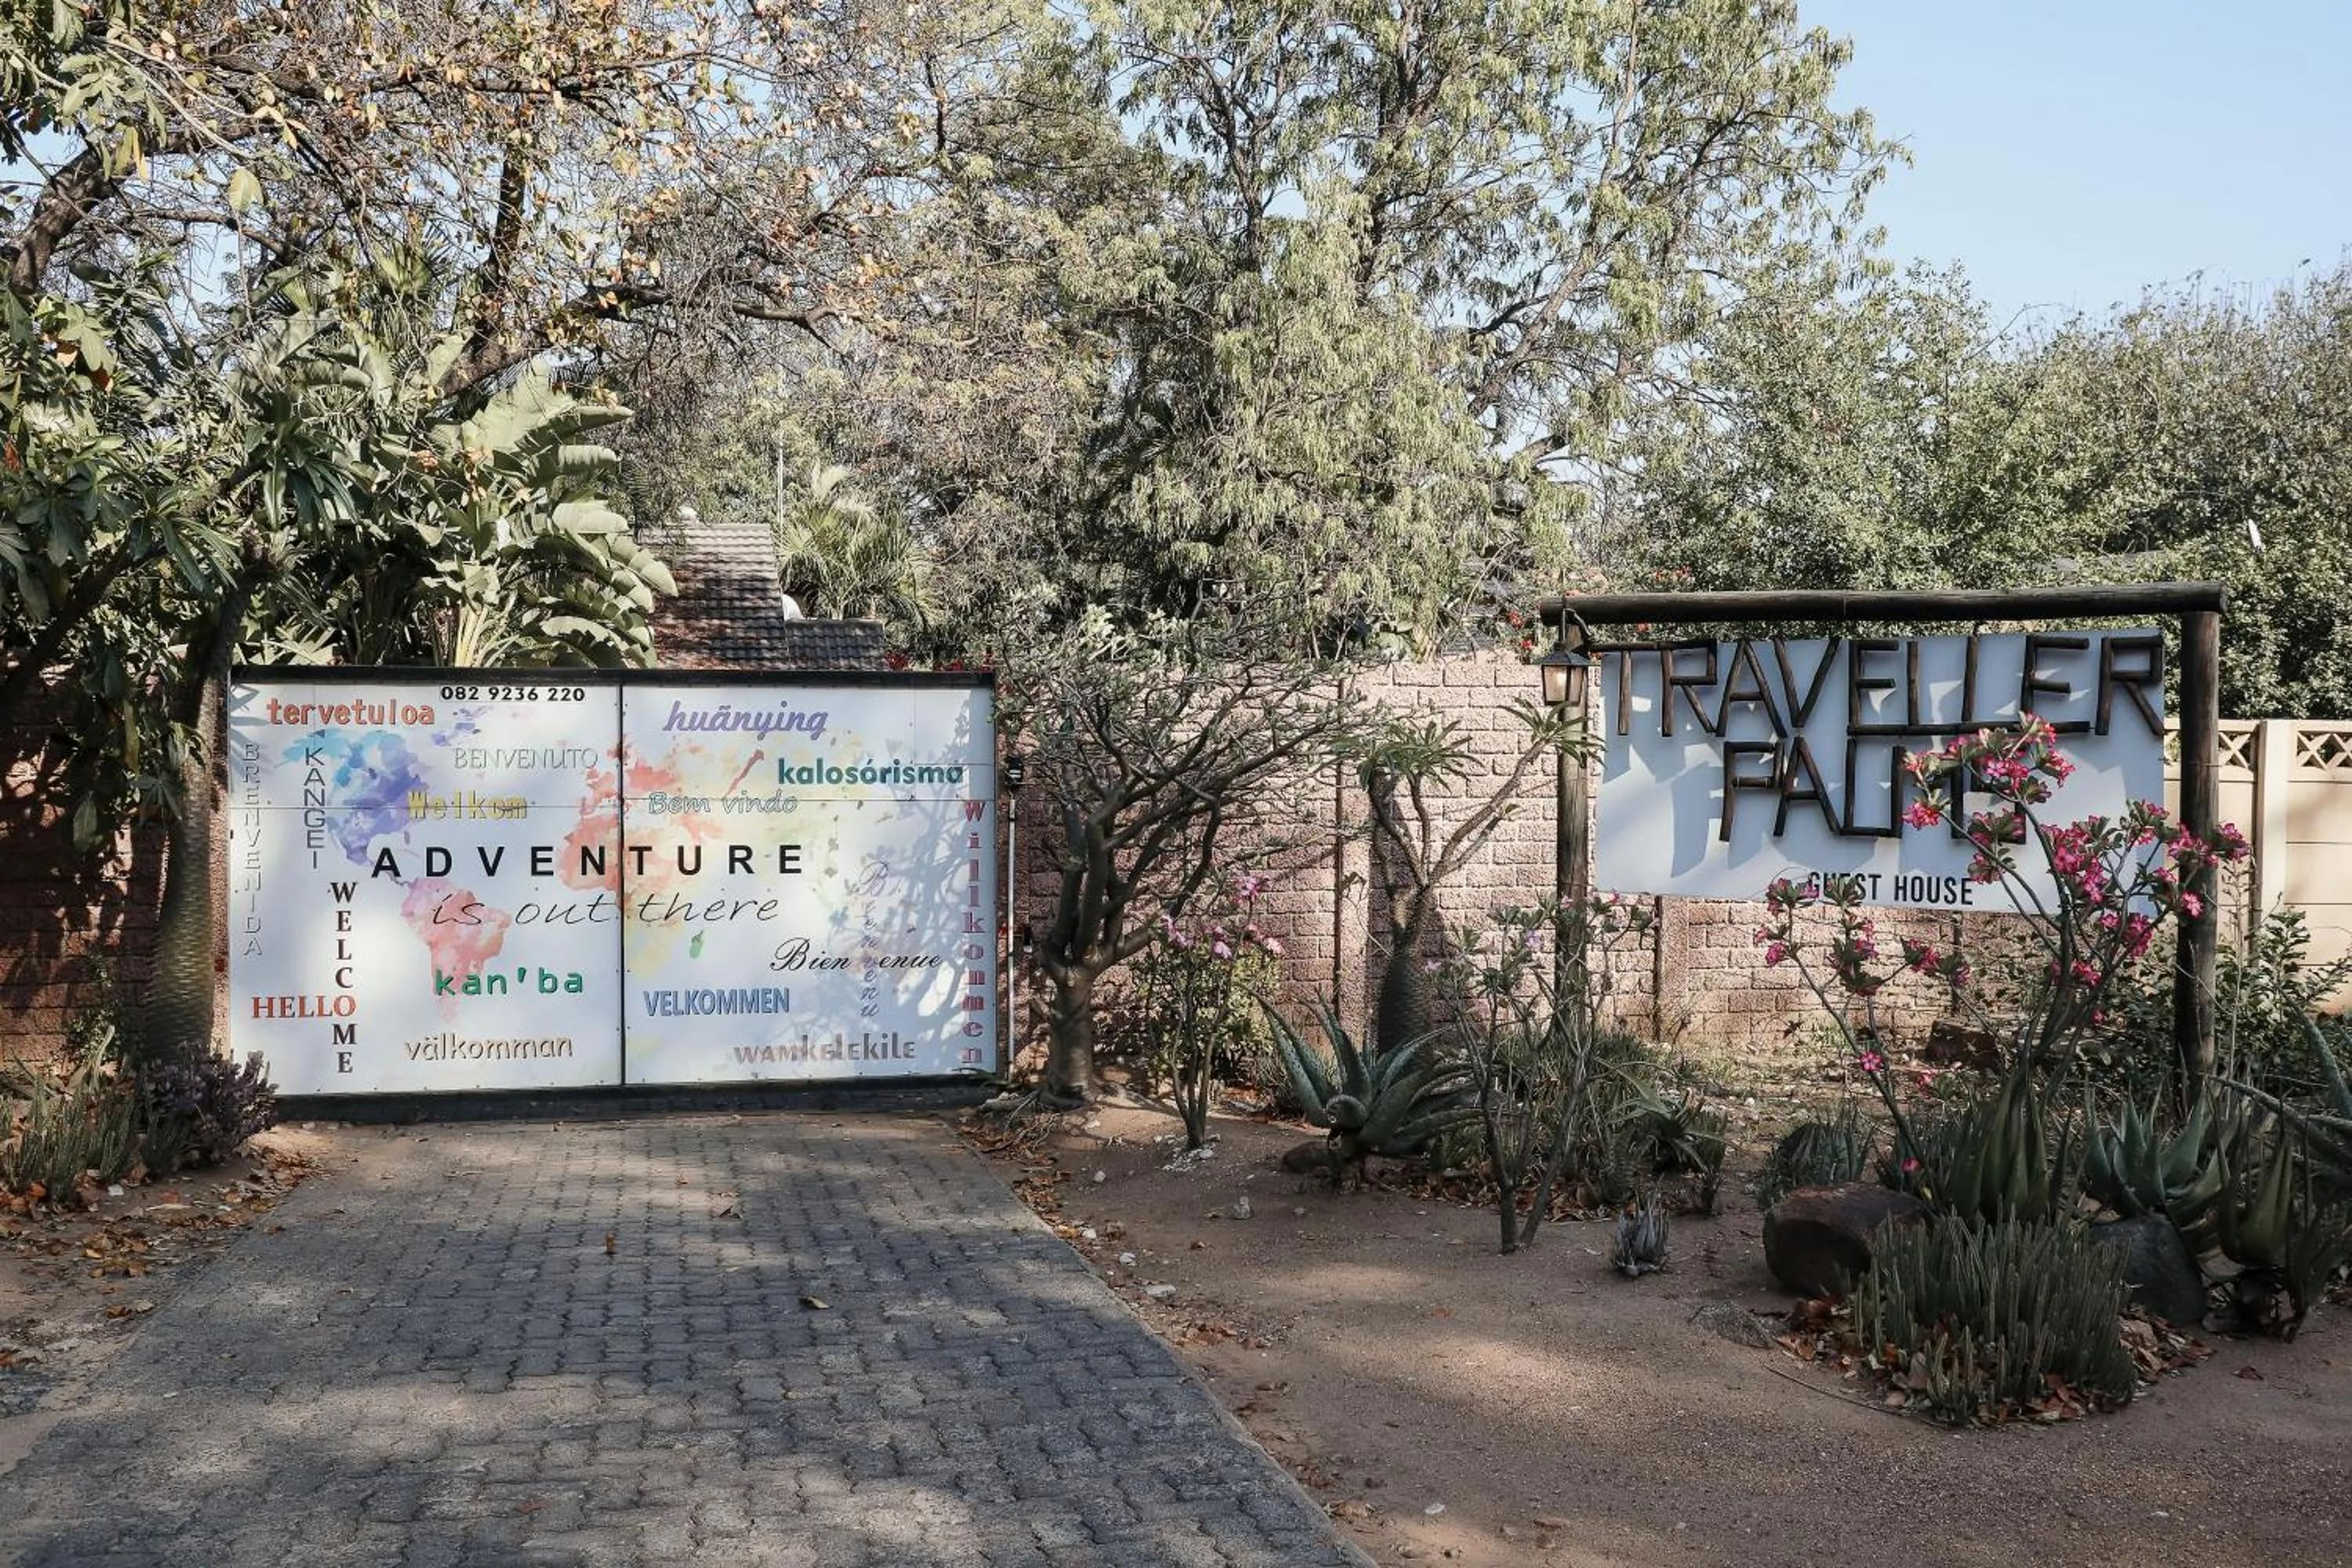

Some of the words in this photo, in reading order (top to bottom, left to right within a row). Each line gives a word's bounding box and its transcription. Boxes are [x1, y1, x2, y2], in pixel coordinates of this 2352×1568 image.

[441, 686, 480, 700] 082
[488, 687, 539, 701] 9236
[547, 687, 586, 702] 220
[1588, 632, 2164, 738] TRAVELLER
[267, 698, 435, 725] tervetuloa
[452, 747, 599, 770] BENVENUTO
[303, 747, 325, 869] KANGEI
[407, 790, 528, 820] Welkom
[648, 792, 711, 815] Bem
[721, 789, 799, 814] vindo
[371, 844, 803, 878] ADVENTURE
[1894, 875, 1973, 905] HOUSE
[433, 894, 484, 925] is
[514, 893, 616, 925] out
[637, 892, 779, 922] there
[330, 882, 358, 1073] WELCOME
[251, 995, 357, 1018] HELLO
[643, 988, 789, 1016] VELKOMMEN
[405, 1033, 574, 1060] välkomman
